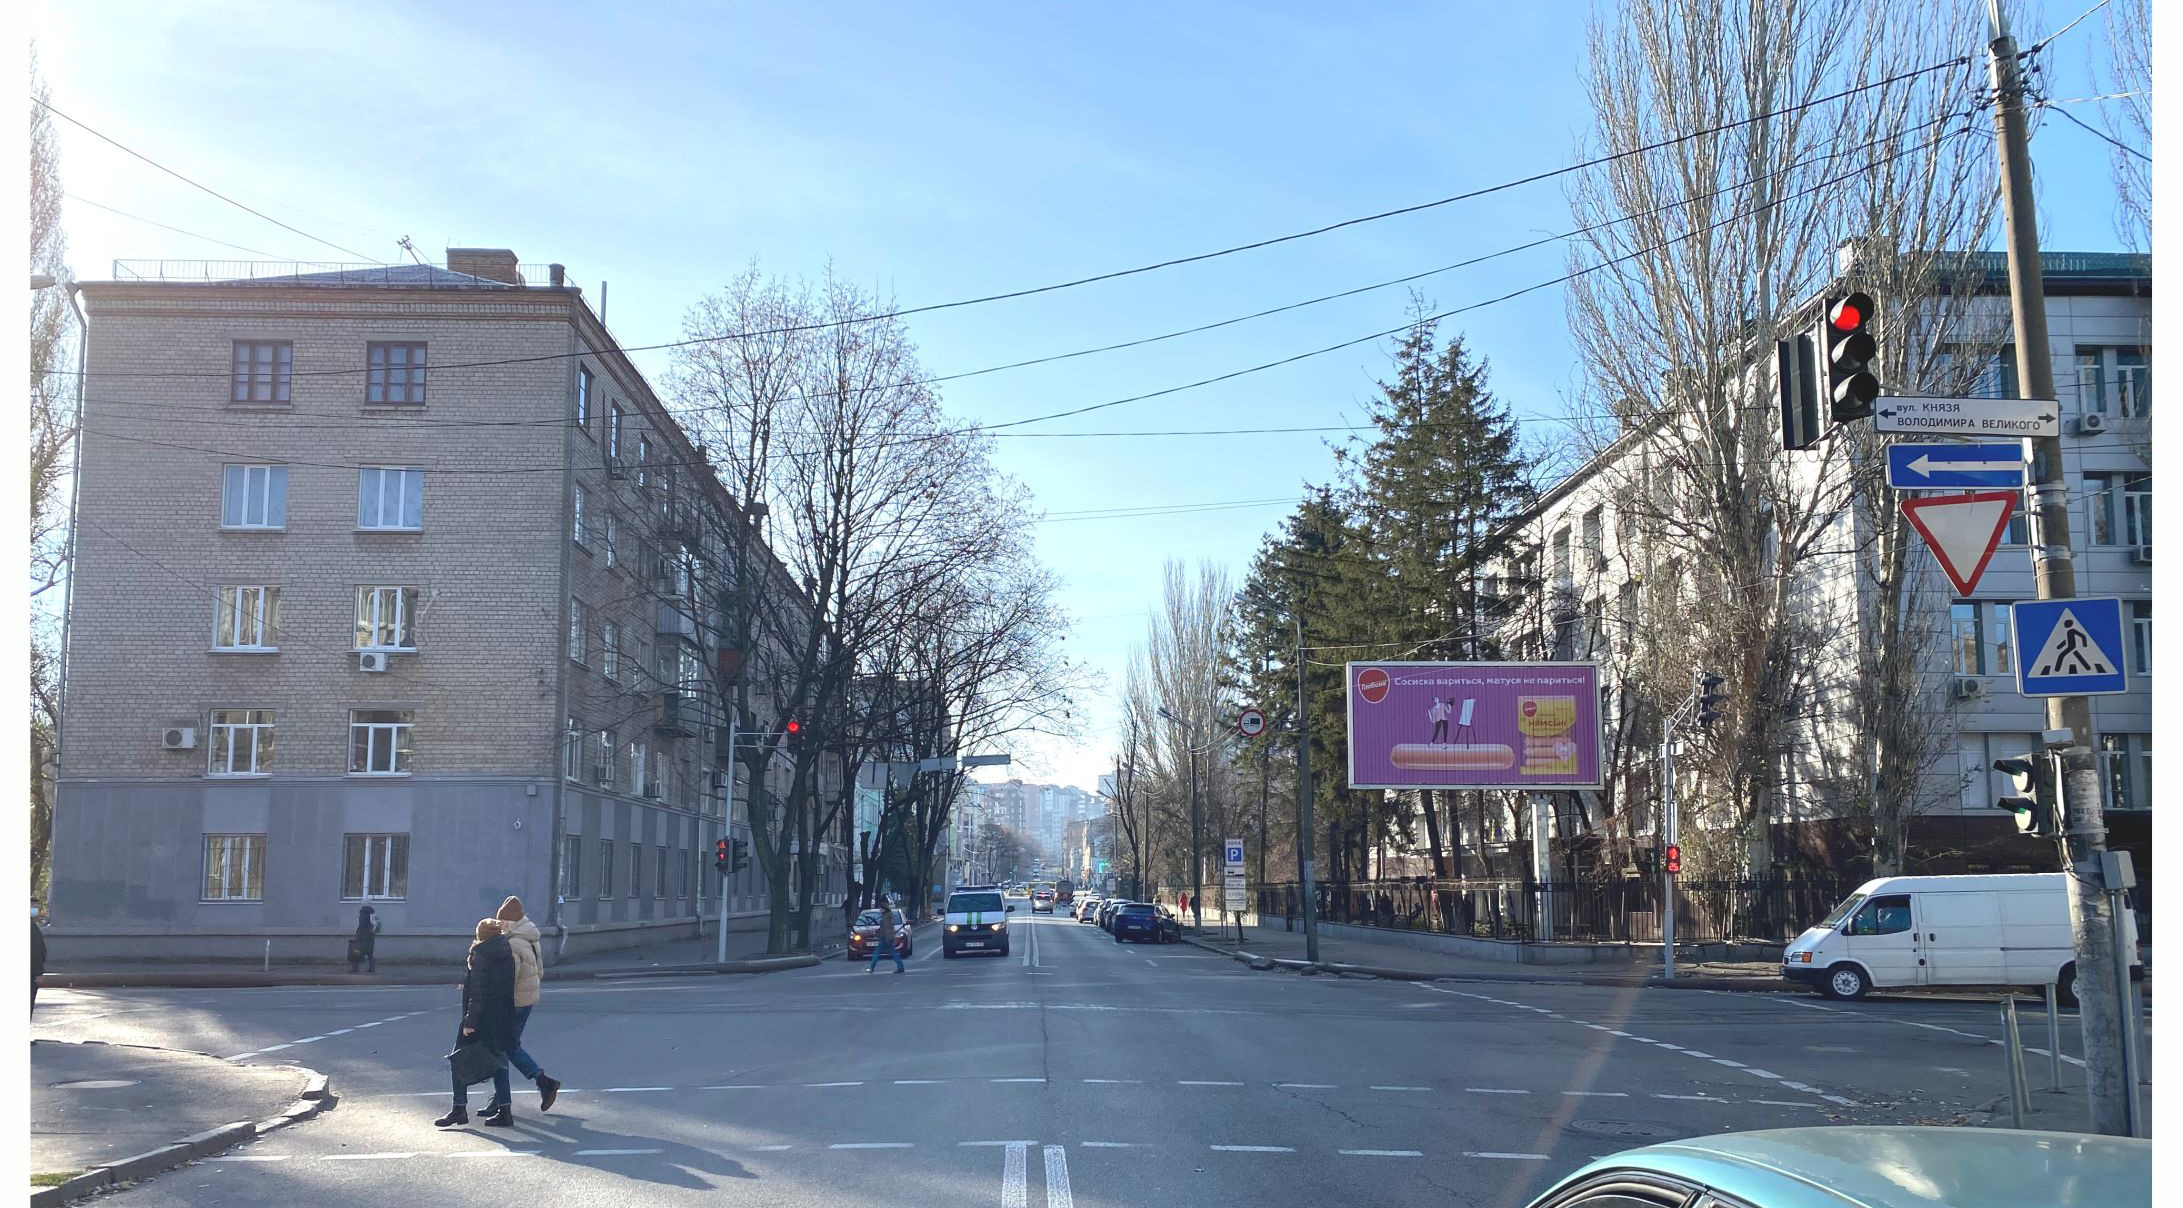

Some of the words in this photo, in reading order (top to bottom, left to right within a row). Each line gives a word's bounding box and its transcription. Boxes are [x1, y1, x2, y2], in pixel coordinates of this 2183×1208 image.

[1896, 404, 1917, 413] вул.
[1922, 403, 1961, 413] КНЯЗЯ
[1897, 417, 1976, 428] ВОЛОДИМИРА
[1982, 419, 2041, 430] ВЕЛИКОГО
[1394, 677, 1434, 685] Сосиска
[1436, 678, 1485, 686] вариться,
[1486, 677, 1522, 686] матуся
[1523, 677, 1535, 685] не
[1537, 675, 1585, 686] париться!
